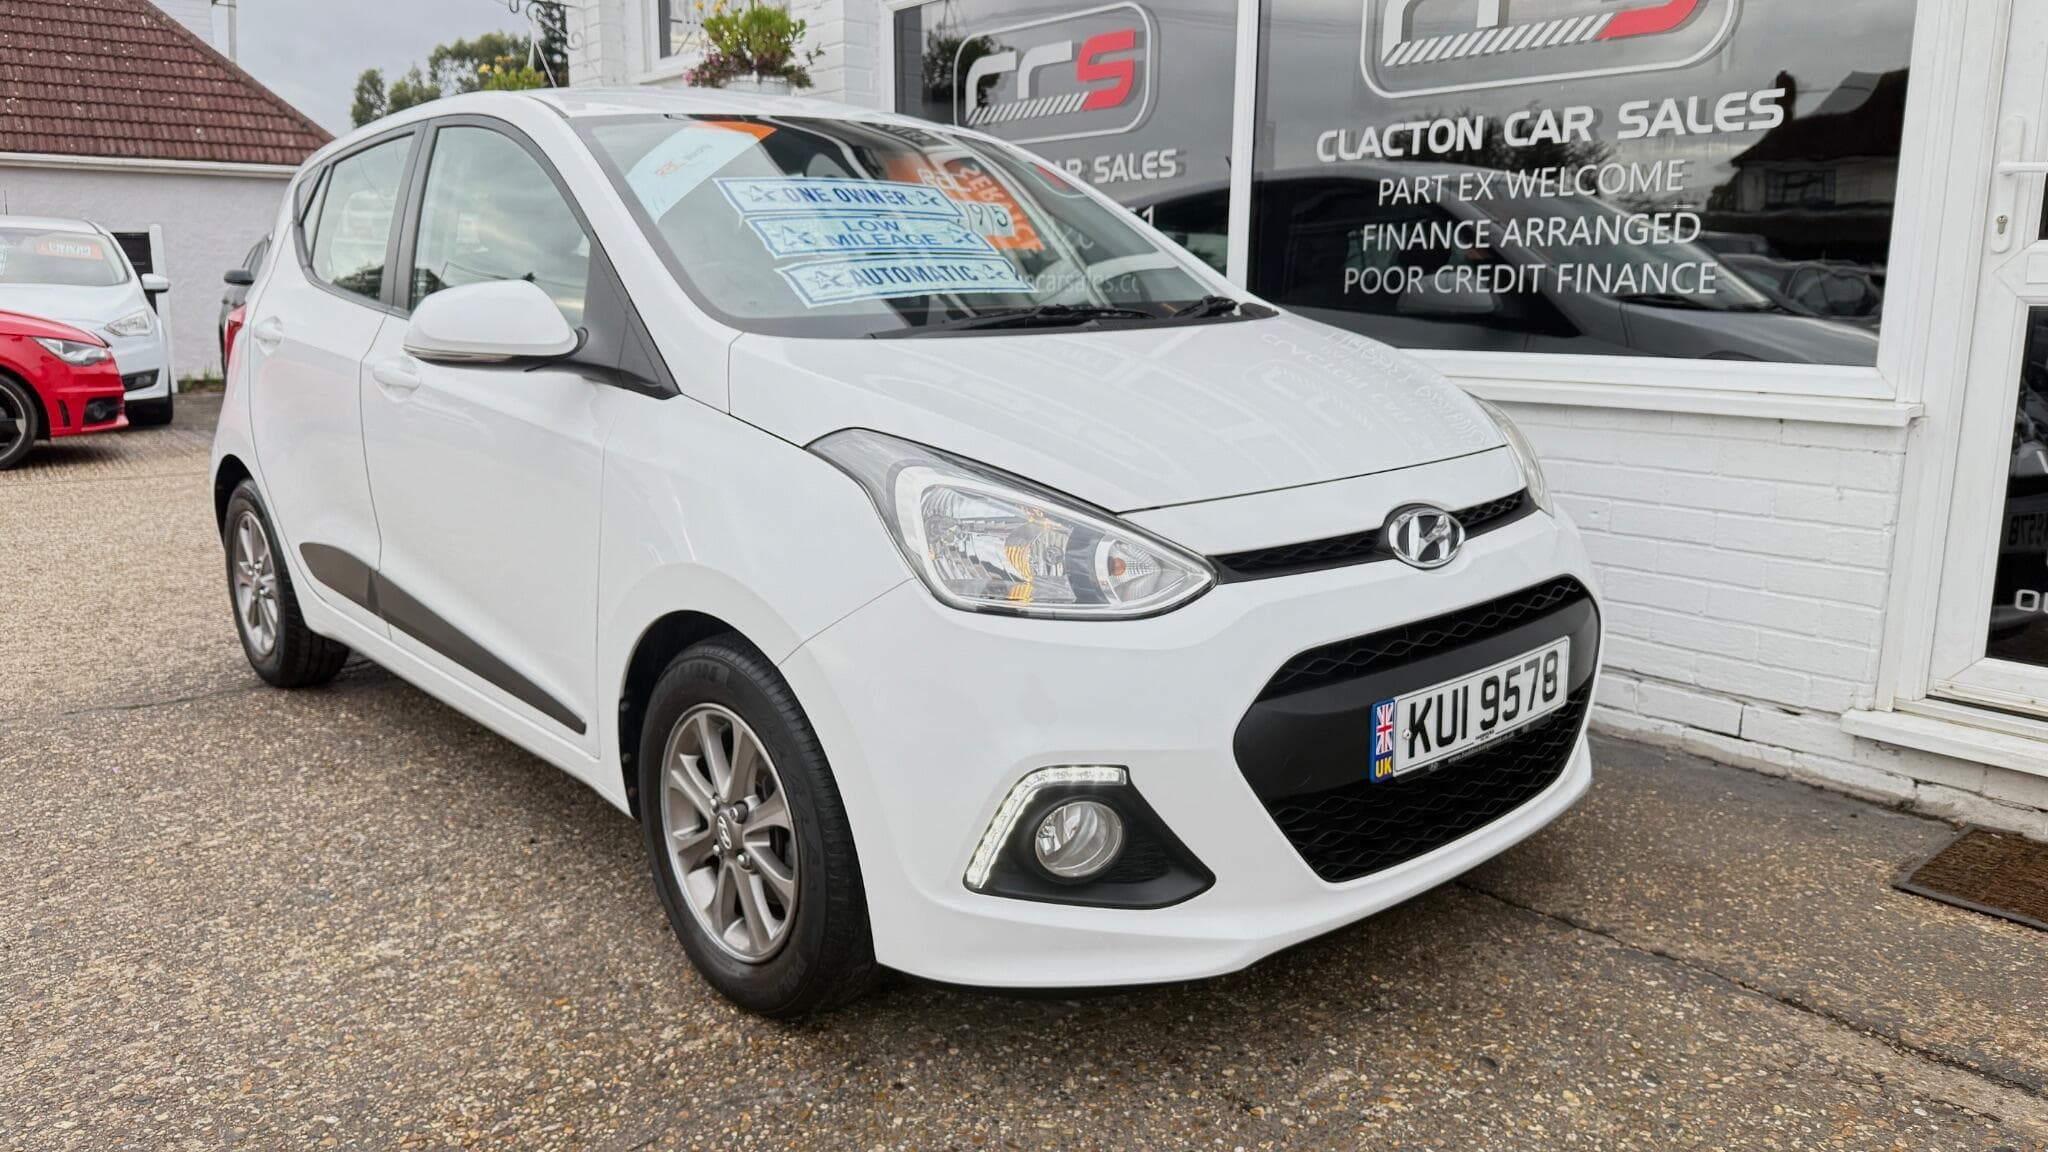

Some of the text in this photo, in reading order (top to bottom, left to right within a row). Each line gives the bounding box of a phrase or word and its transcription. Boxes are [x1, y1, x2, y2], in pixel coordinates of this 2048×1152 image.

[1315, 88, 1786, 163] CLACTON CAR SALES
[1093, 148, 1177, 184] SALES
[1377, 159, 1685, 207] PART EX WELCOME
[783, 187, 914, 206] ONE OWNER
[825, 232, 942, 247] MILEAGE
[842, 219, 901, 233] LOW
[1361, 211, 1702, 253] FINANCE ARRANGED
[850, 265, 979, 288] AUTOMATIC
[1343, 260, 1718, 295] POOR CREDIT FINANCE
[1408, 684, 1469, 758] KUI
[1480, 650, 1559, 731] 9578
[1375, 755, 1392, 778] UK
